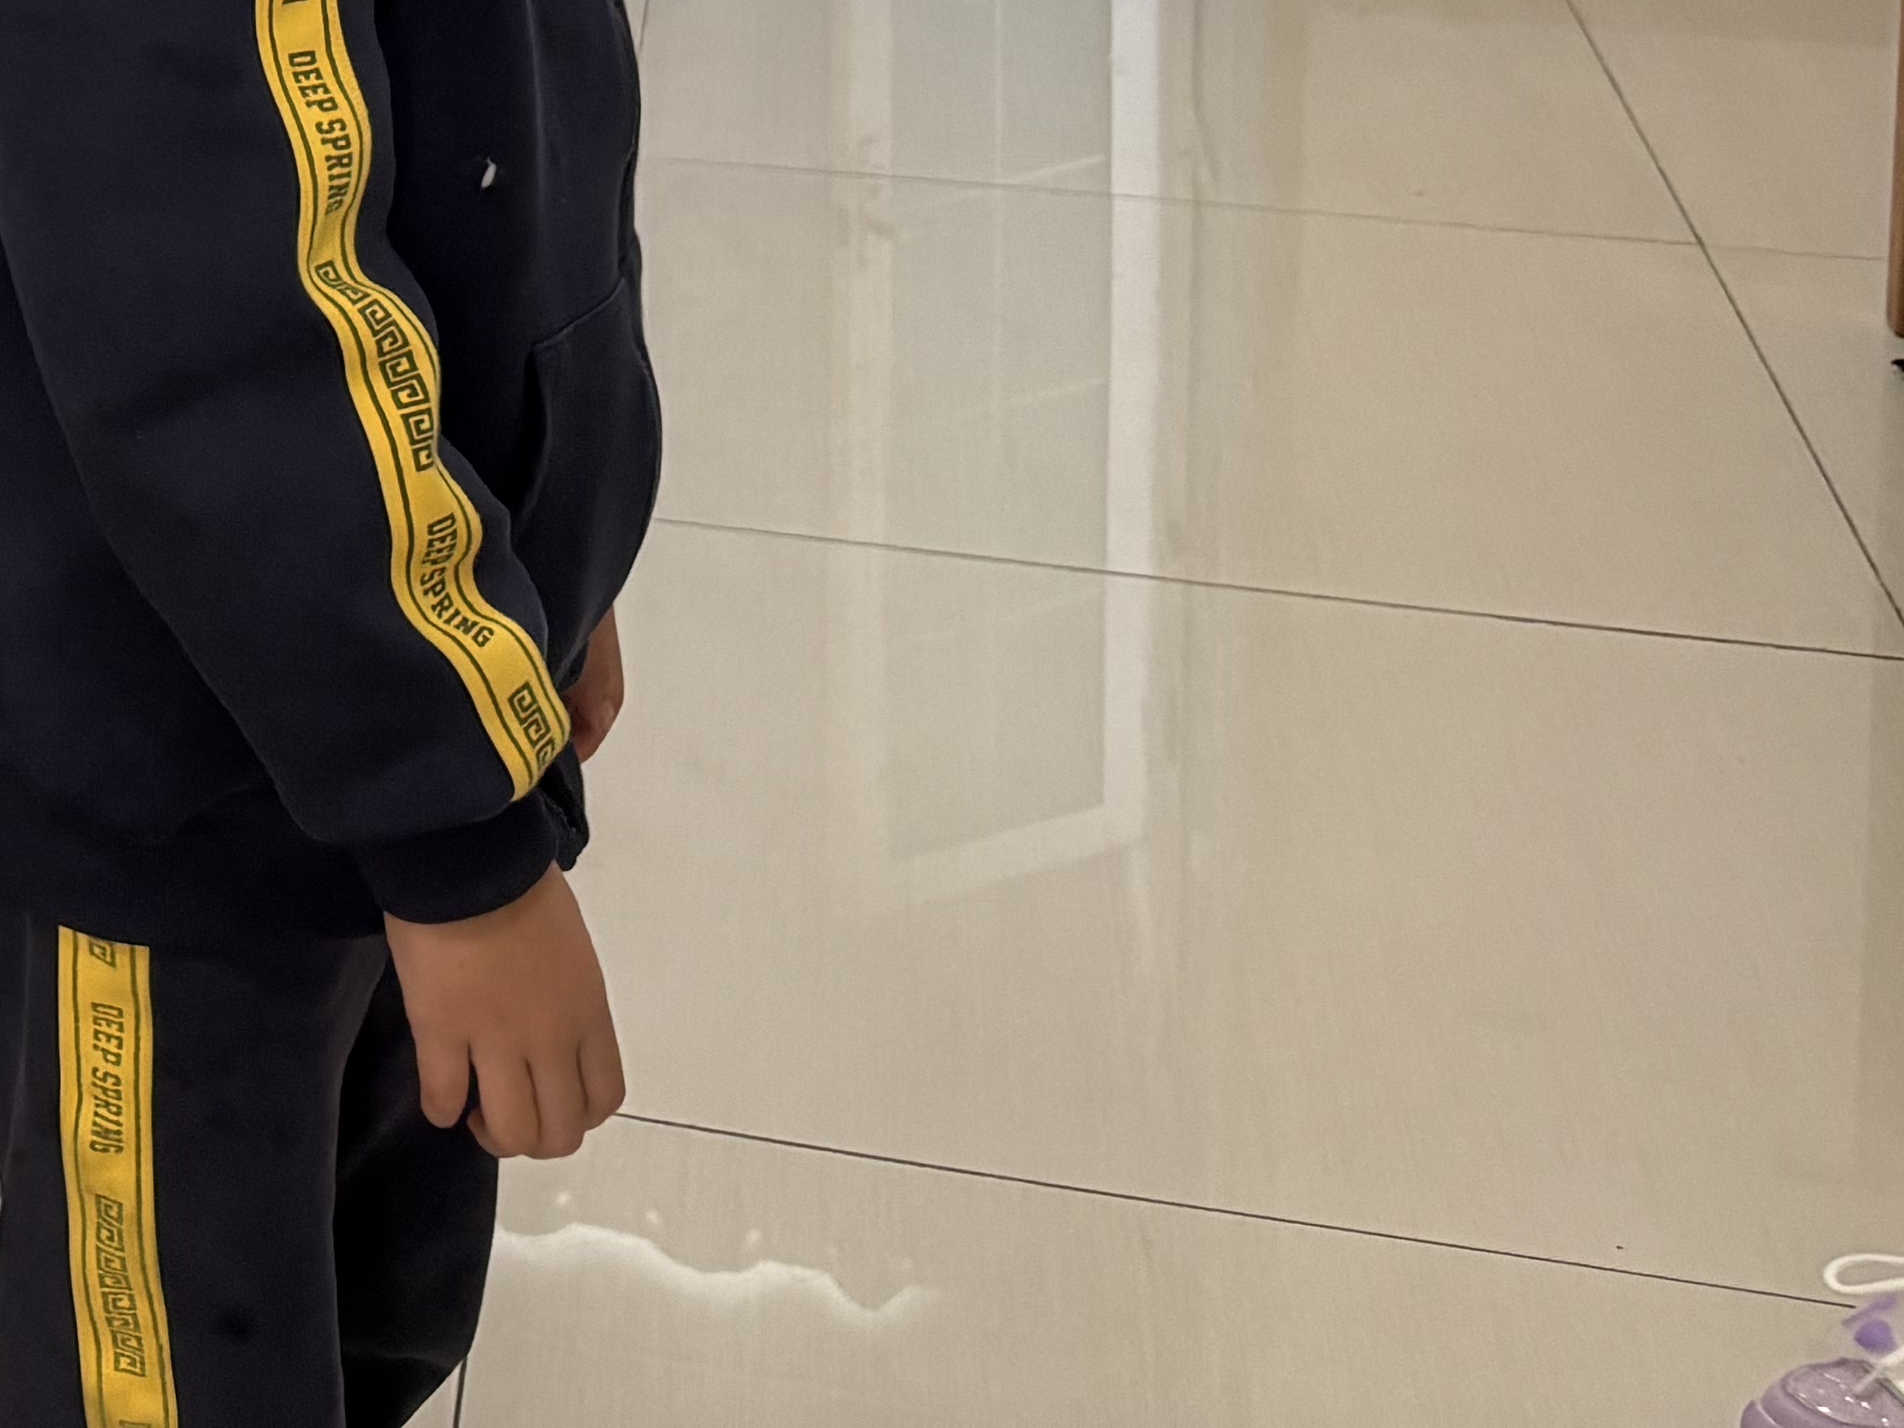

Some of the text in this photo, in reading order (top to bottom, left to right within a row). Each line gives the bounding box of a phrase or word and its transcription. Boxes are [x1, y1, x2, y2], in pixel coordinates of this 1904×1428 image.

[288, 50, 339, 114] DEEP
[420, 512, 495, 648] DEEP SPRING
[89, 1001, 125, 1155] DEEP SPRING
